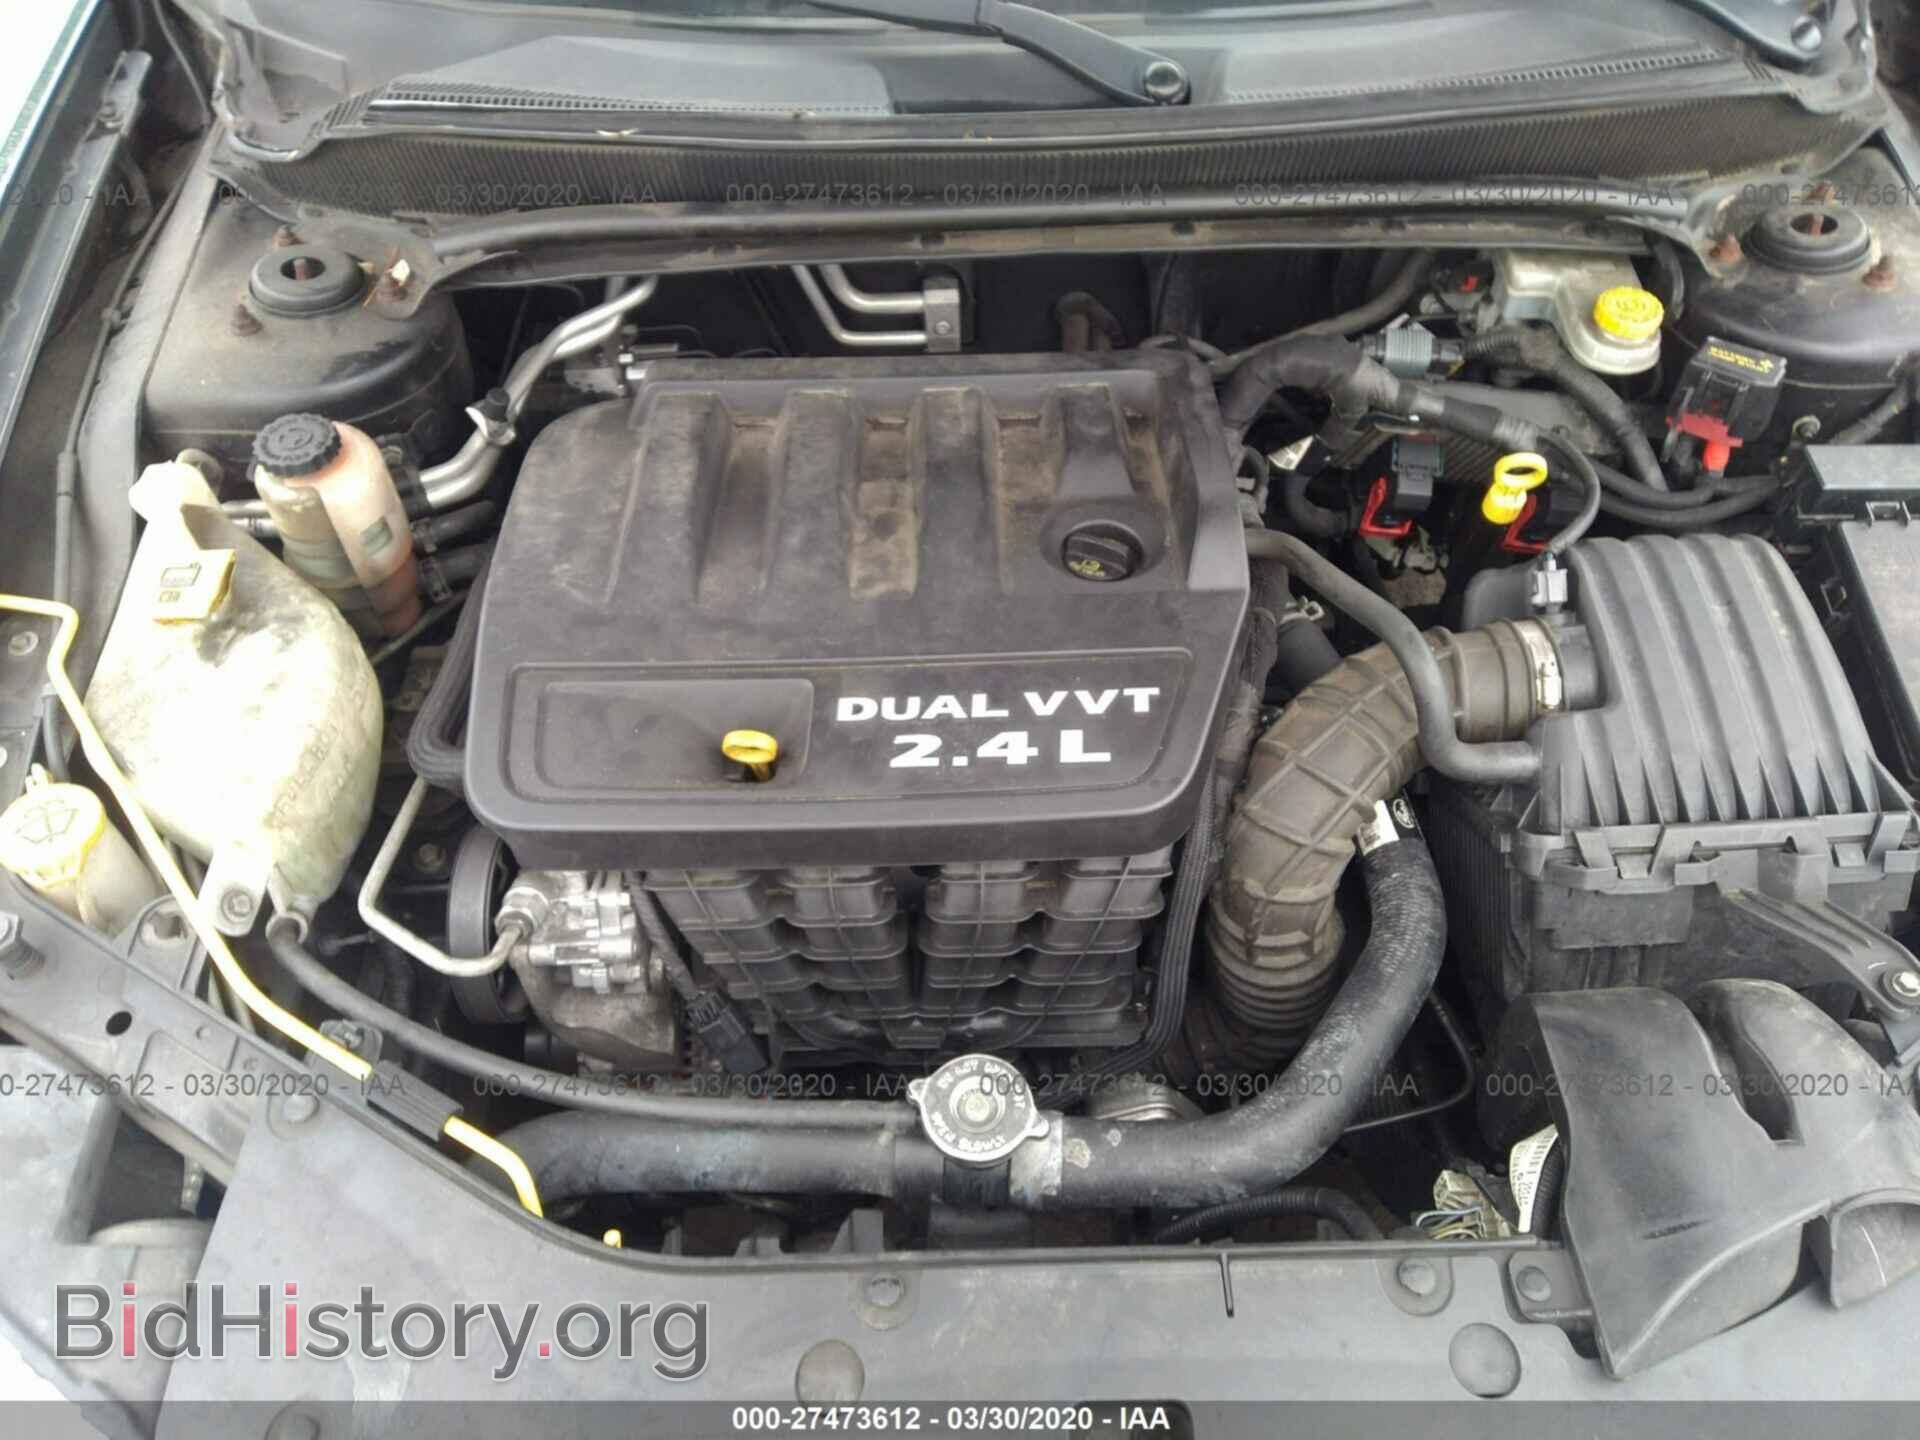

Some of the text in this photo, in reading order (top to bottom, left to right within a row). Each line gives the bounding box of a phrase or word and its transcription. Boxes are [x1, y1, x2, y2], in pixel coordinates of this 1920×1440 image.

[836, 687, 1160, 722] DUAL VVT
[889, 729, 1111, 768] 2.4 L
